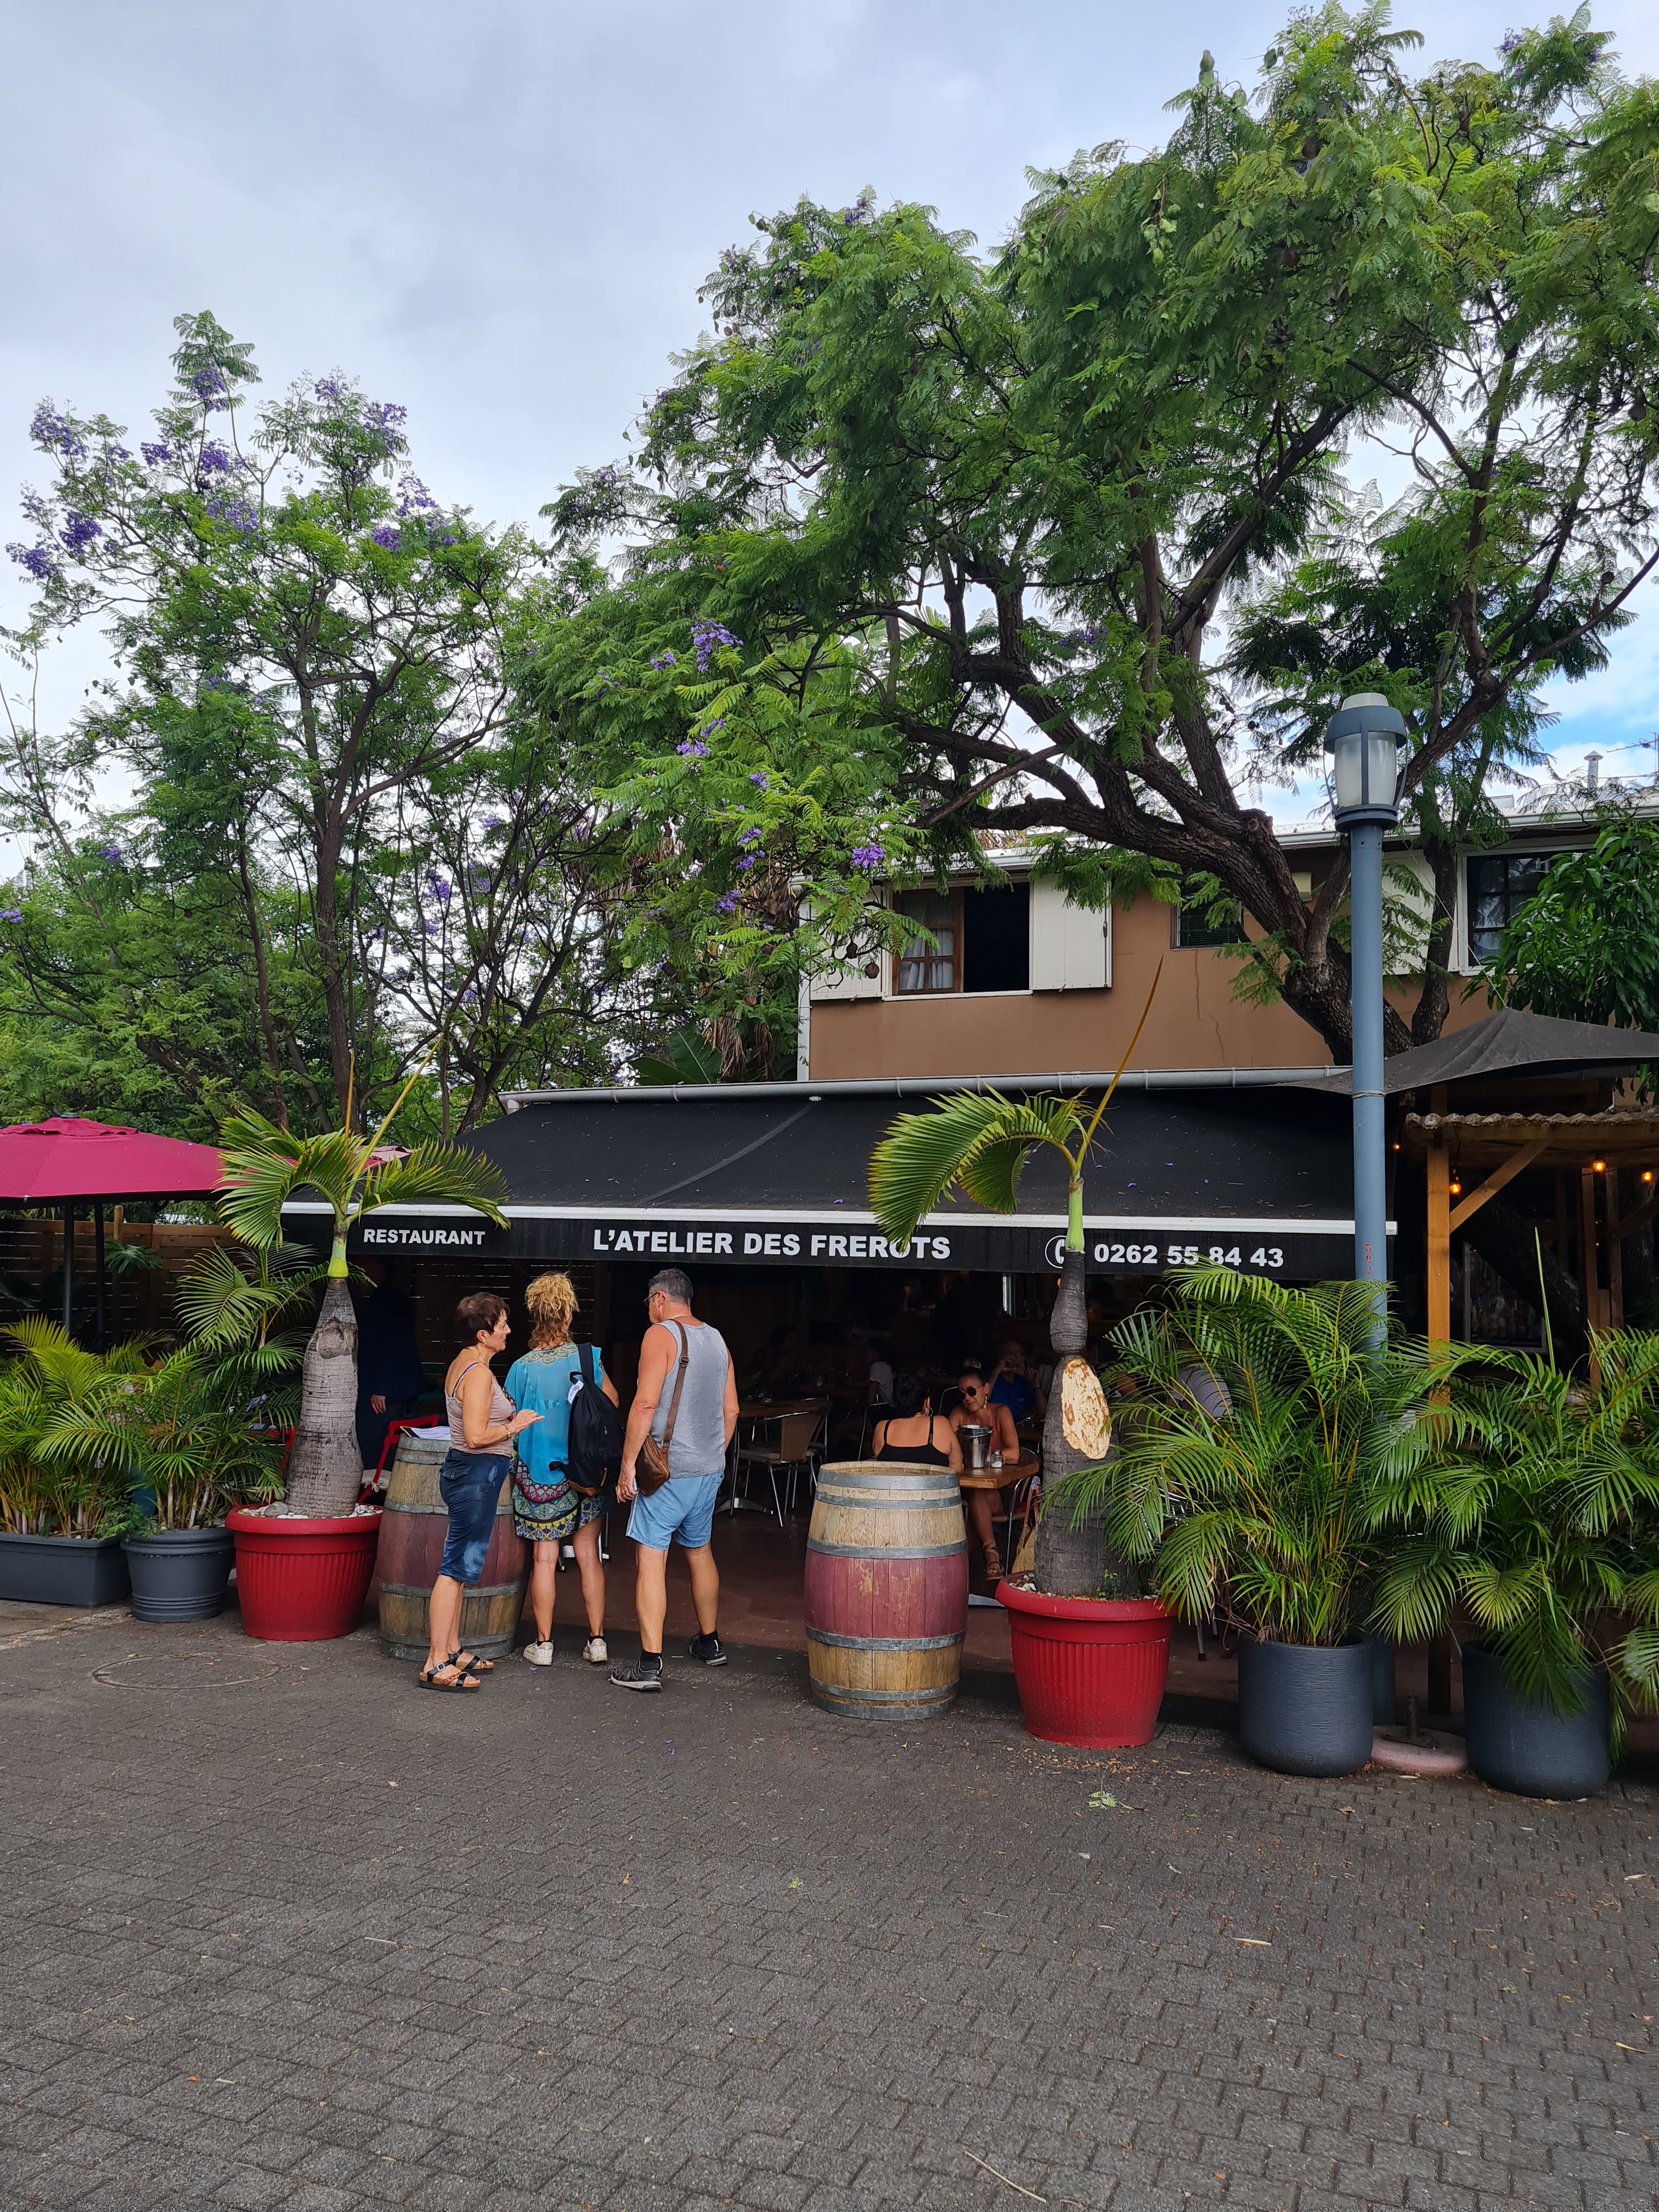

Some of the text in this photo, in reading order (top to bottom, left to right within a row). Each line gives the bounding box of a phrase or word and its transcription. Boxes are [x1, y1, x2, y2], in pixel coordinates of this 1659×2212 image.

[363, 1228, 486, 1245] RESTAURANT
[594, 1229, 950, 1259] L'ATELIER DES FREROTS
[1094, 1244, 1284, 1267] 0262 55 84 43
